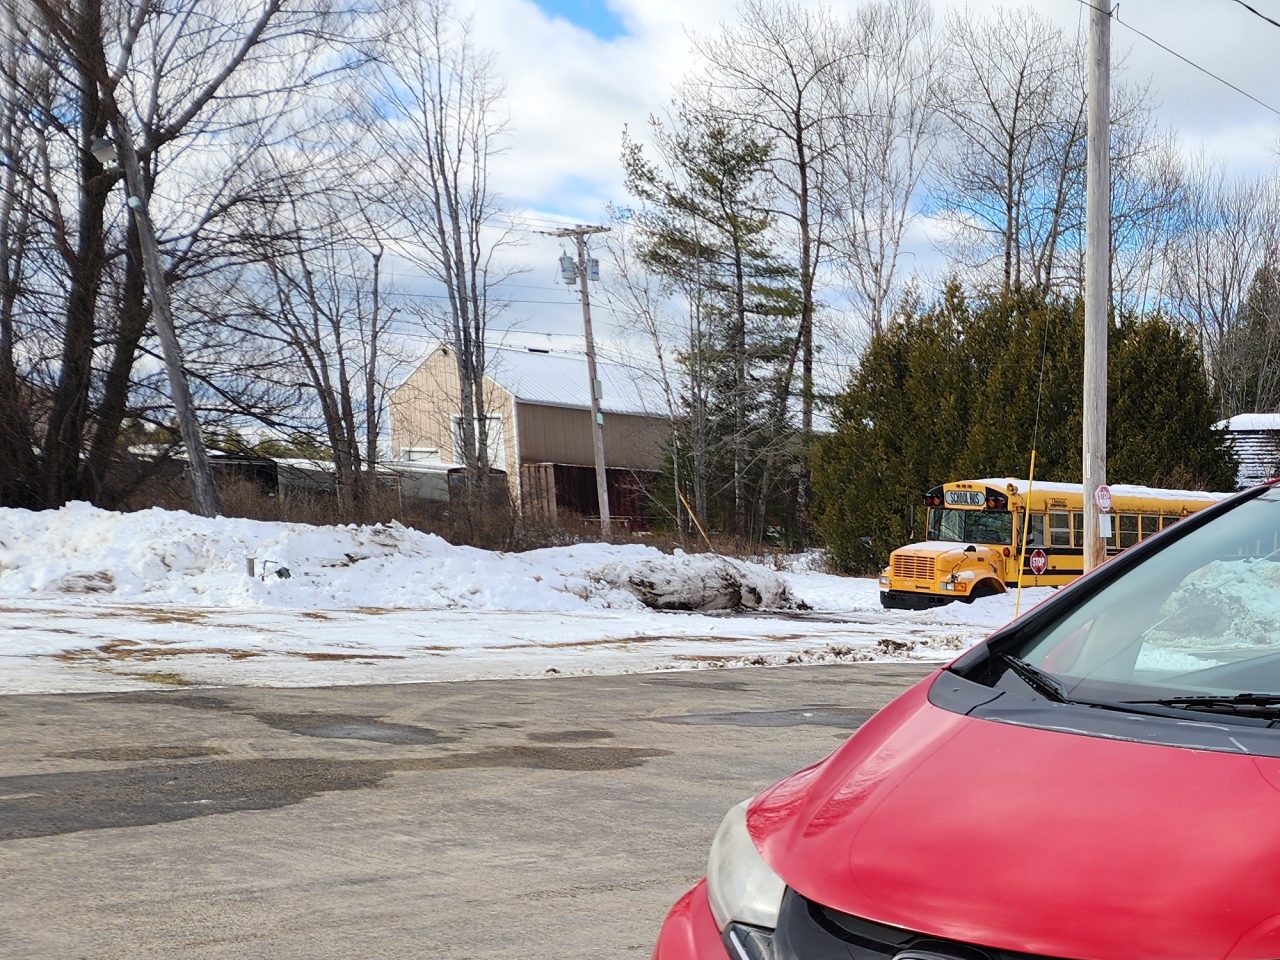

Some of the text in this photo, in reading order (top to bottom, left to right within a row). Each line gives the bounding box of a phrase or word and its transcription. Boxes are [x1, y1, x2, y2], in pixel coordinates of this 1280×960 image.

[950, 492, 980, 505] SCHOOL BUS
[1032, 557, 1045, 567] STOP
